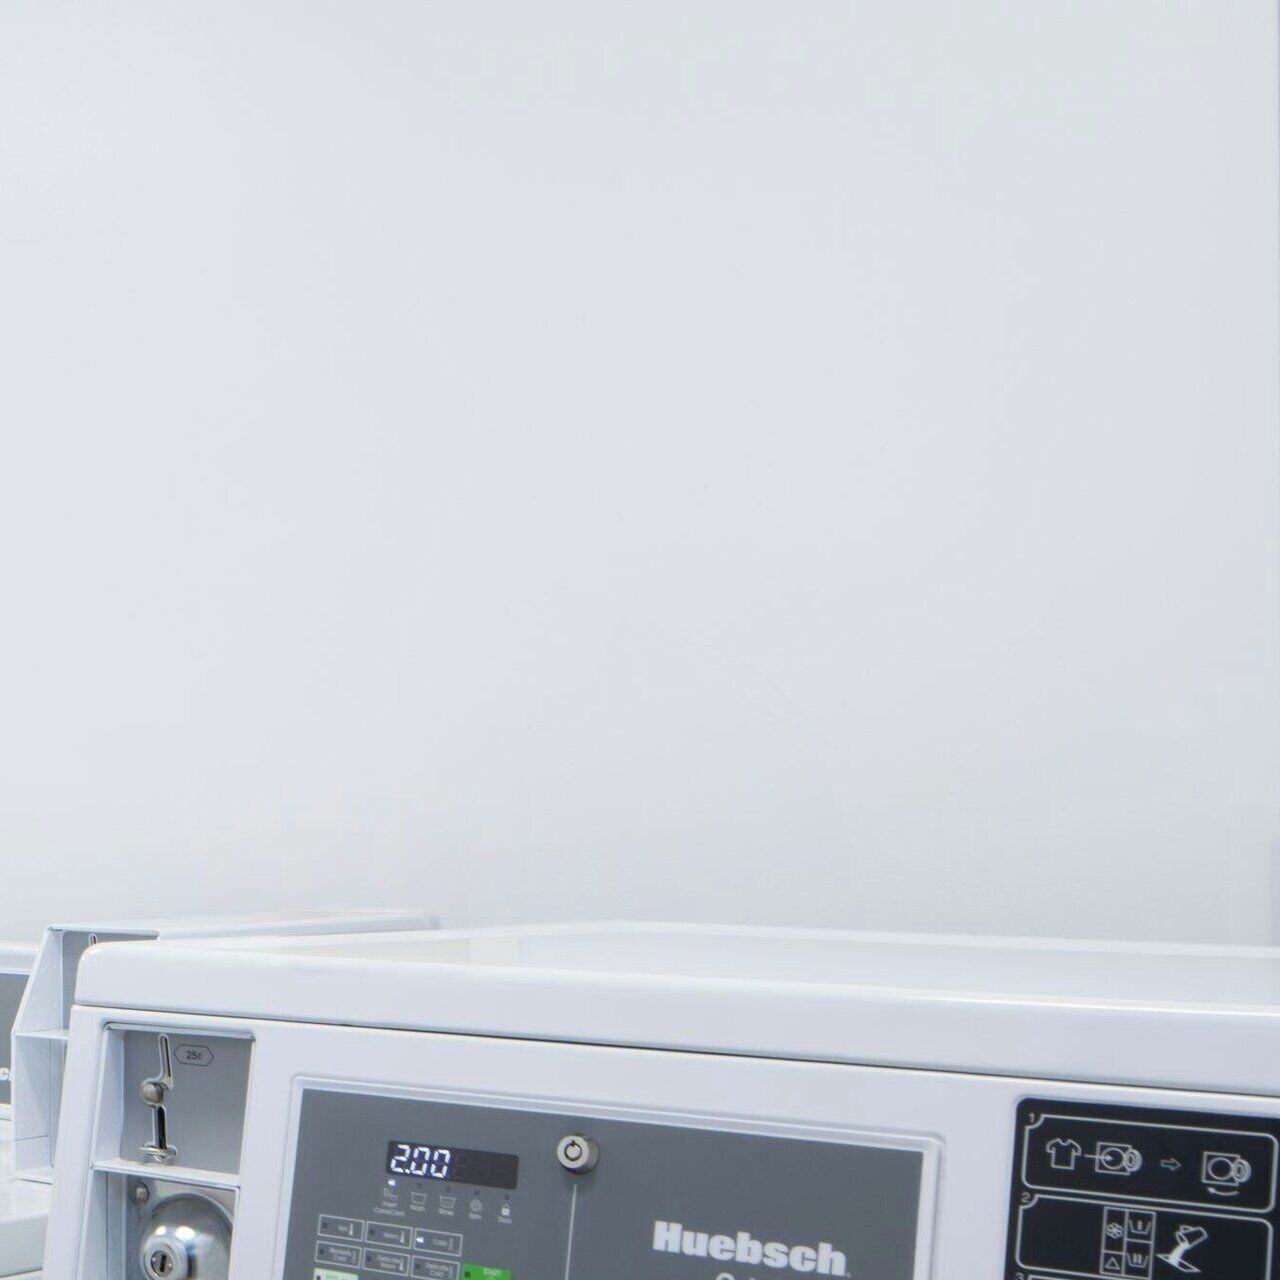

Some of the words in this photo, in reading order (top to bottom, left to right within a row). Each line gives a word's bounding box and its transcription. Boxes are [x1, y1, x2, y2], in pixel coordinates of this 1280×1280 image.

[1028, 1113, 1035, 1123] 1
[390, 1144, 451, 1179] 2.00
[1022, 1192, 1031, 1203] 2
[652, 1220, 847, 1277] Huebsch
